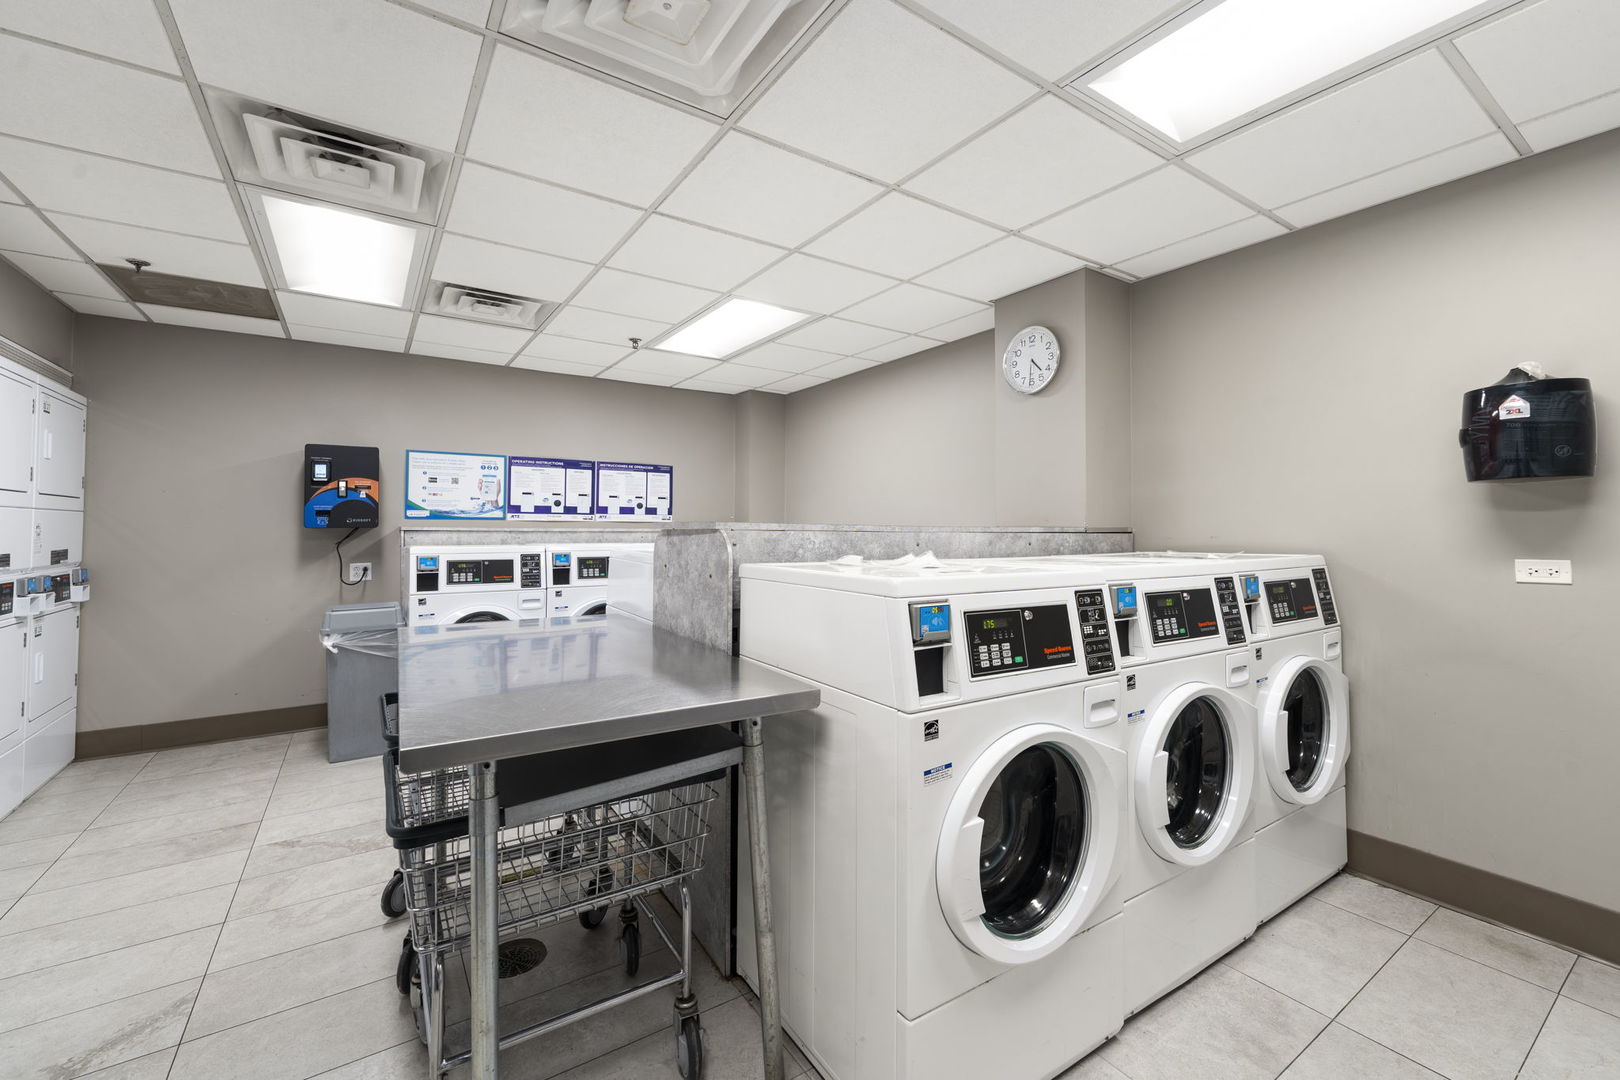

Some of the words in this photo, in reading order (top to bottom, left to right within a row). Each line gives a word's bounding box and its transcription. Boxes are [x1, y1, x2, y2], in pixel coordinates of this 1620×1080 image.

[1029, 334, 1036, 343] 12
[1045, 341, 1052, 350] 2
[1012, 349, 1022, 358] 10
[1047, 352, 1054, 360] 3
[1011, 360, 1018, 368] 9
[1014, 370, 1020, 378] 8
[1038, 373, 1044, 381] 5
[1021, 376, 1026, 384] 7
[1029, 377, 1035, 386] 6
